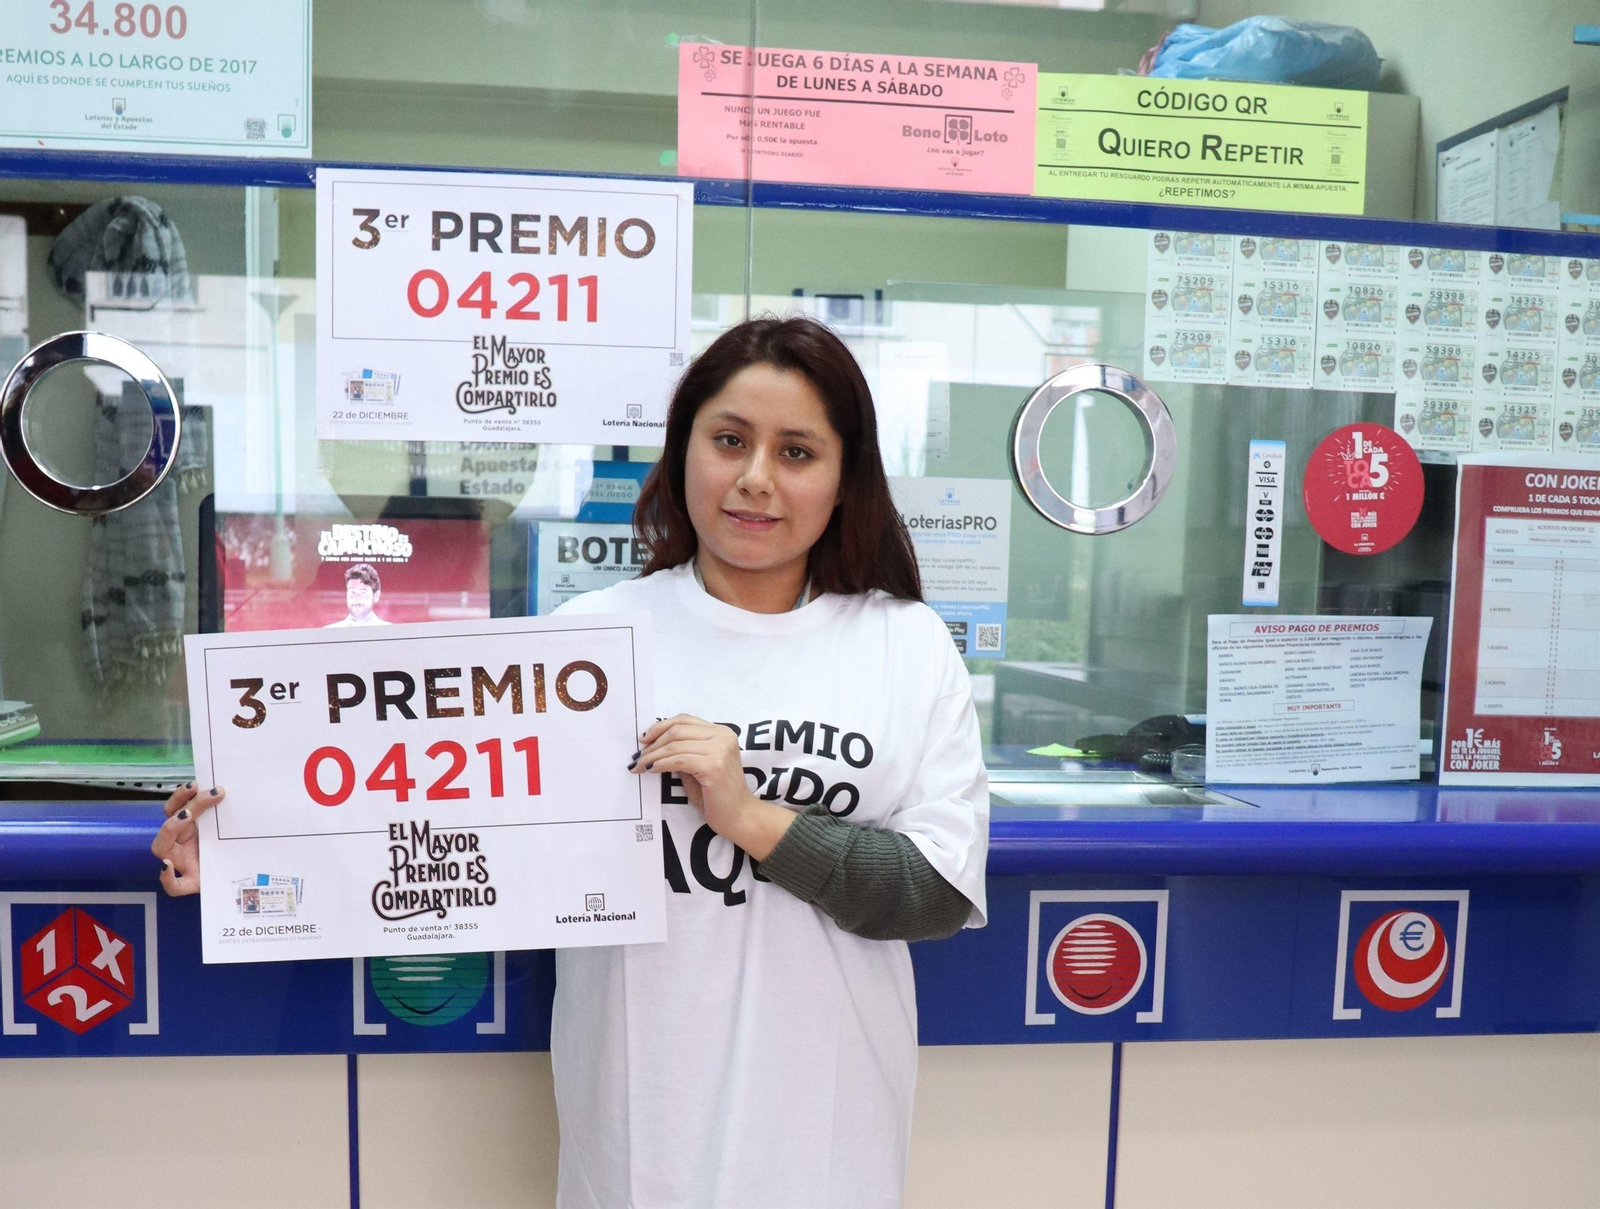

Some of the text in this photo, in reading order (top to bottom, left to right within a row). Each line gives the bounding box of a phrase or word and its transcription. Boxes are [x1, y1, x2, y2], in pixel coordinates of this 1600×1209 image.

[49, 0, 187, 40] 34.800
[0, 48, 258, 74] EMIOS A LO LARGO DE 2017
[720, 50, 742, 65] SE
[813, 56, 824, 70] 6
[829, 53, 874, 73] DÍAS
[879, 60, 891, 74] A
[897, 61, 919, 76] LA
[924, 63, 998, 82] SEMANA
[6, 73, 231, 92] AQUÍ ES DONDE SE CUMPLEN TUS SUEÑOS
[776, 75, 943, 97] DE LUNES A SÁBADO
[1137, 86, 1268, 115] CÓDIGO QR
[724, 105, 821, 117] NUNC UN JUEGO FUE
[760, 120, 806, 130] RENTABLE
[902, 125, 1008, 143] Bono Loto
[789, 138, 818, 146] apuesta
[1098, 127, 1191, 160] QUIERO
[1201, 133, 1304, 166] REPETIR
[961, 149, 984, 157] jugar?
[1060, 170, 1098, 178] ENTREGAR
[1110, 172, 1151, 181] RESGUARDO
[1181, 177, 1211, 185] REPETIR
[1212, 177, 1281, 188] AUTOMÁTICAMENTE
[1293, 182, 1314, 190] MISMA
[1158, 186, 1236, 199] ¿REPETIMOS?
[431, 210, 656, 259] PREMIO
[1176, 275, 1214, 285] 75209
[1262, 280, 1299, 290] 15316
[407, 268, 598, 323] 04211
[1349, 286, 1383, 296] 10826
[1430, 290, 1465, 300] 59398
[1511, 296, 1544, 306] 14325
[1174, 331, 1211, 341] 75209
[1260, 336, 1297, 346] 15316
[473, 334, 546, 369] EL MAYOR
[1346, 341, 1380, 351] 10826
[1426, 345, 1461, 355] 59398
[1507, 350, 1540, 360] 14325
[472, 353, 552, 389] PREMIO ES
[456, 381, 557, 415] COMPARTIRLO
[1423, 400, 1458, 410] 59398
[1503, 404, 1537, 414] 14325
[333, 411, 409, 420] 22 de DICIEMBRE
[602, 418, 665, 428] Lotería Nacional
[1352, 431, 1363, 459] 1
[1363, 446, 1384, 454] CADA
[1370, 453, 1389, 488] 5
[460, 477, 525, 495] Estado
[1525, 473, 1558, 488] CON
[1352, 491, 1378, 500] MILLÓN
[1528, 494, 1534, 502] 1
[1535, 494, 1546, 503] DE
[1548, 495, 1571, 504] CADA
[1572, 496, 1577, 504] 5
[1492, 505, 1530, 513] COMPRUEBA
[1543, 507, 1570, 515] PREMIOS
[332, 524, 399, 542] DESTINO
[1254, 623, 1380, 633] AVISO PAGO DE PREMIOS
[327, 660, 608, 725] PREMIO
[1302, 702, 1342, 711] IMPORTANTE
[1451, 740, 1467, 748] POR
[1483, 738, 1501, 748] MÁS
[1552, 742, 1561, 760] 5
[303, 736, 541, 807] 04211
[1450, 760, 1500, 770] CON JOKER
[388, 820, 480, 862] EL MAYOR
[388, 845, 489, 888] PREMIO ES
[371, 880, 496, 921] COMPARTIRLO
[555, 911, 636, 924] Lotería Nacional
[222, 924, 317, 937] 22 de DICIEMBRE
[420, 924, 442, 932] venta
[454, 922, 479, 930] 38355
[406, 932, 456, 941] Guadalajara.
[1399, 920, 1427, 952] €
[36, 929, 57, 976] 1
[90, 924, 126, 986] X
[47, 984, 113, 1023] 2
